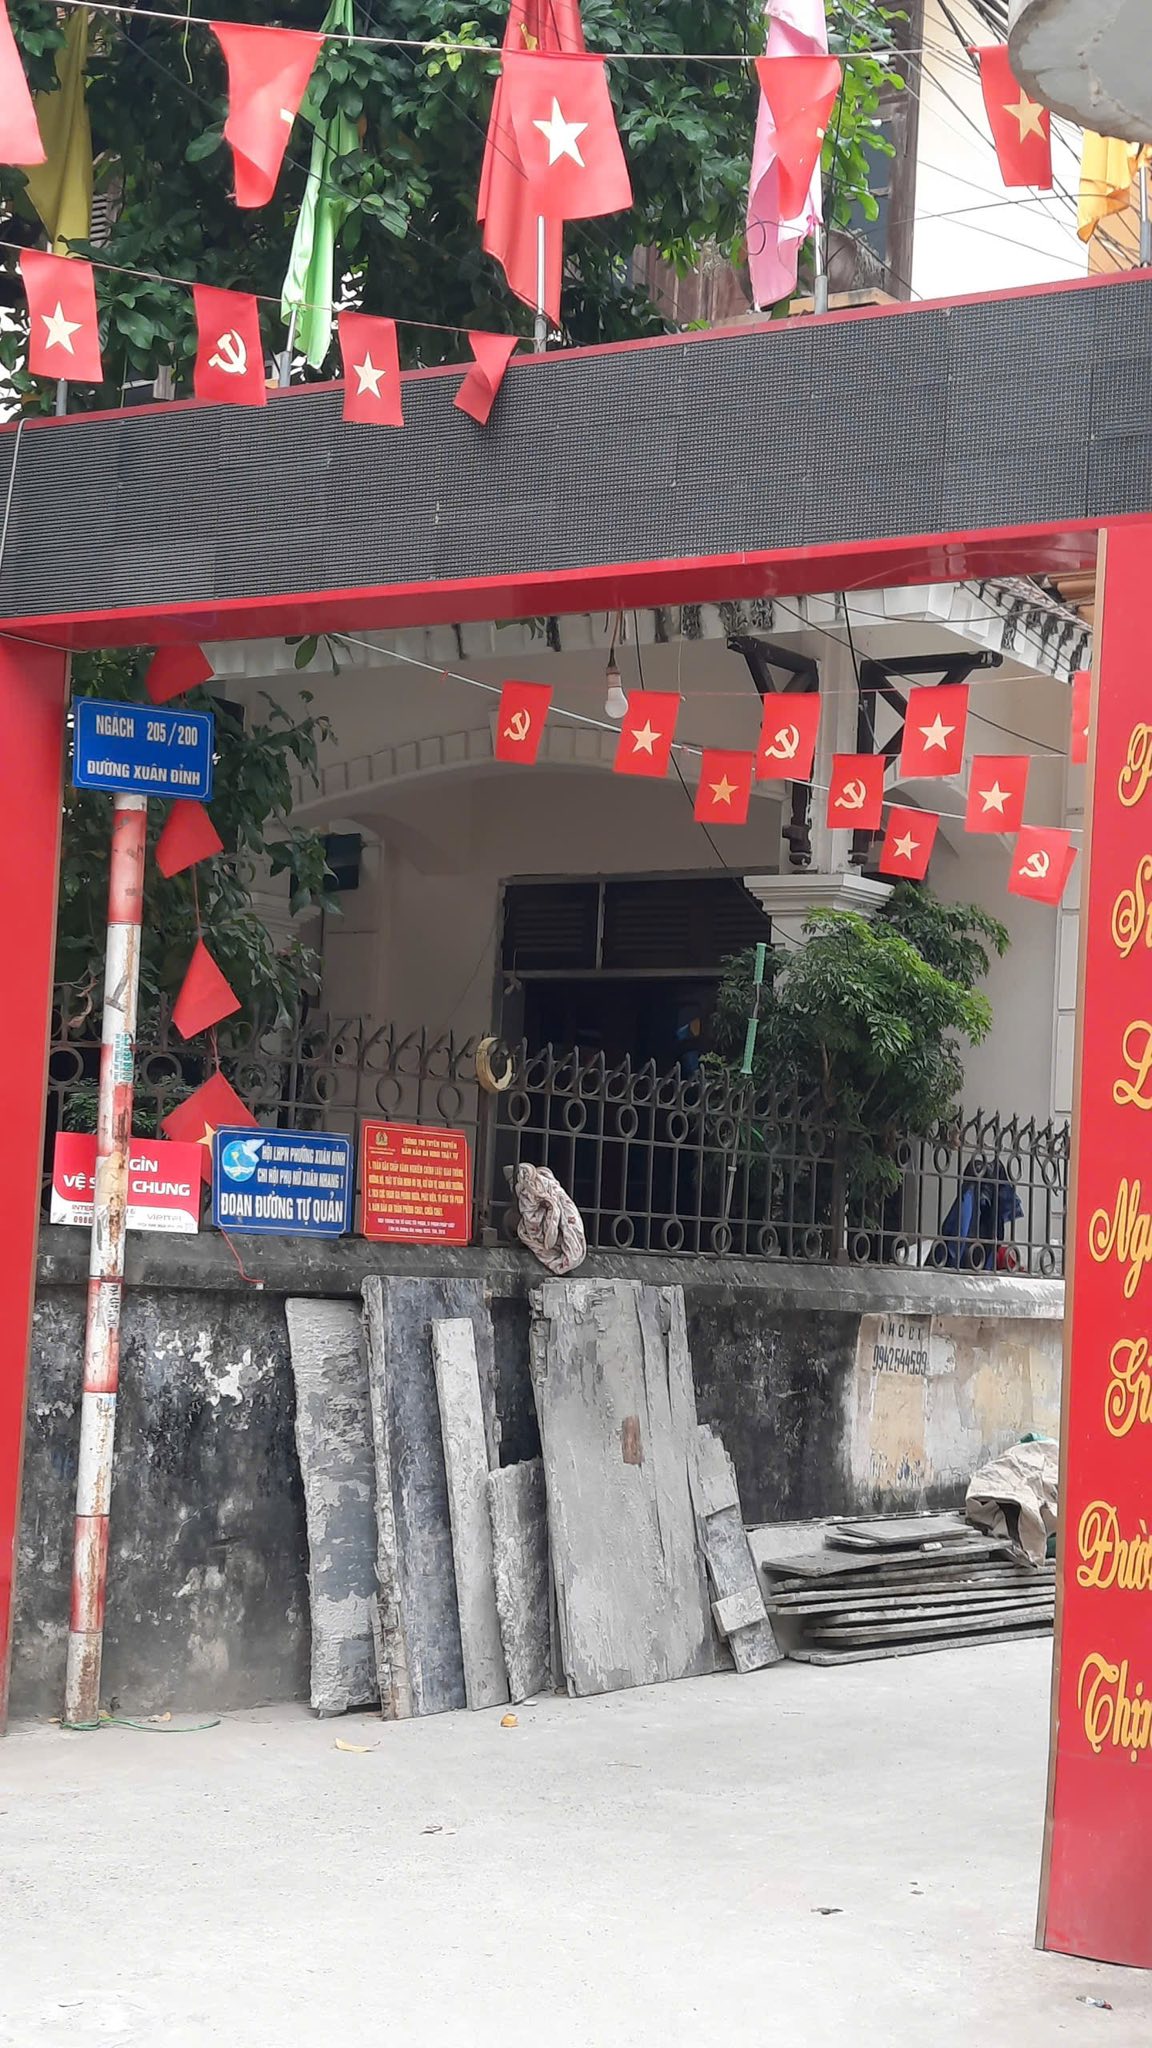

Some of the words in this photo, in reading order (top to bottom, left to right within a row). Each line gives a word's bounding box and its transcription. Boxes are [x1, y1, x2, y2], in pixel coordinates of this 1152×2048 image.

[147, 722, 197, 746] 205/200
[87, 758, 130, 778] ĐƯỜNG
[133, 763, 167, 782] XUÂN
[171, 764, 200, 786] ĐỈNH
[129, 1156, 158, 1172] GÌN
[274, 1146, 289, 1161] LHPN
[290, 1145, 314, 1163] PHƯỜNG
[315, 1147, 330, 1164] XUÂN
[63, 1172, 86, 1190] VỆ
[132, 1180, 190, 1196] CHUNG
[257, 1168, 267, 1182] CHI
[279, 1170, 291, 1188] PHỤ
[303, 1169, 318, 1186] XUÂN
[255, 1191, 293, 1219] ĐƯỜNG
[296, 1198, 311, 1225] TỰ
[313, 1192, 343, 1223] QUẢN
